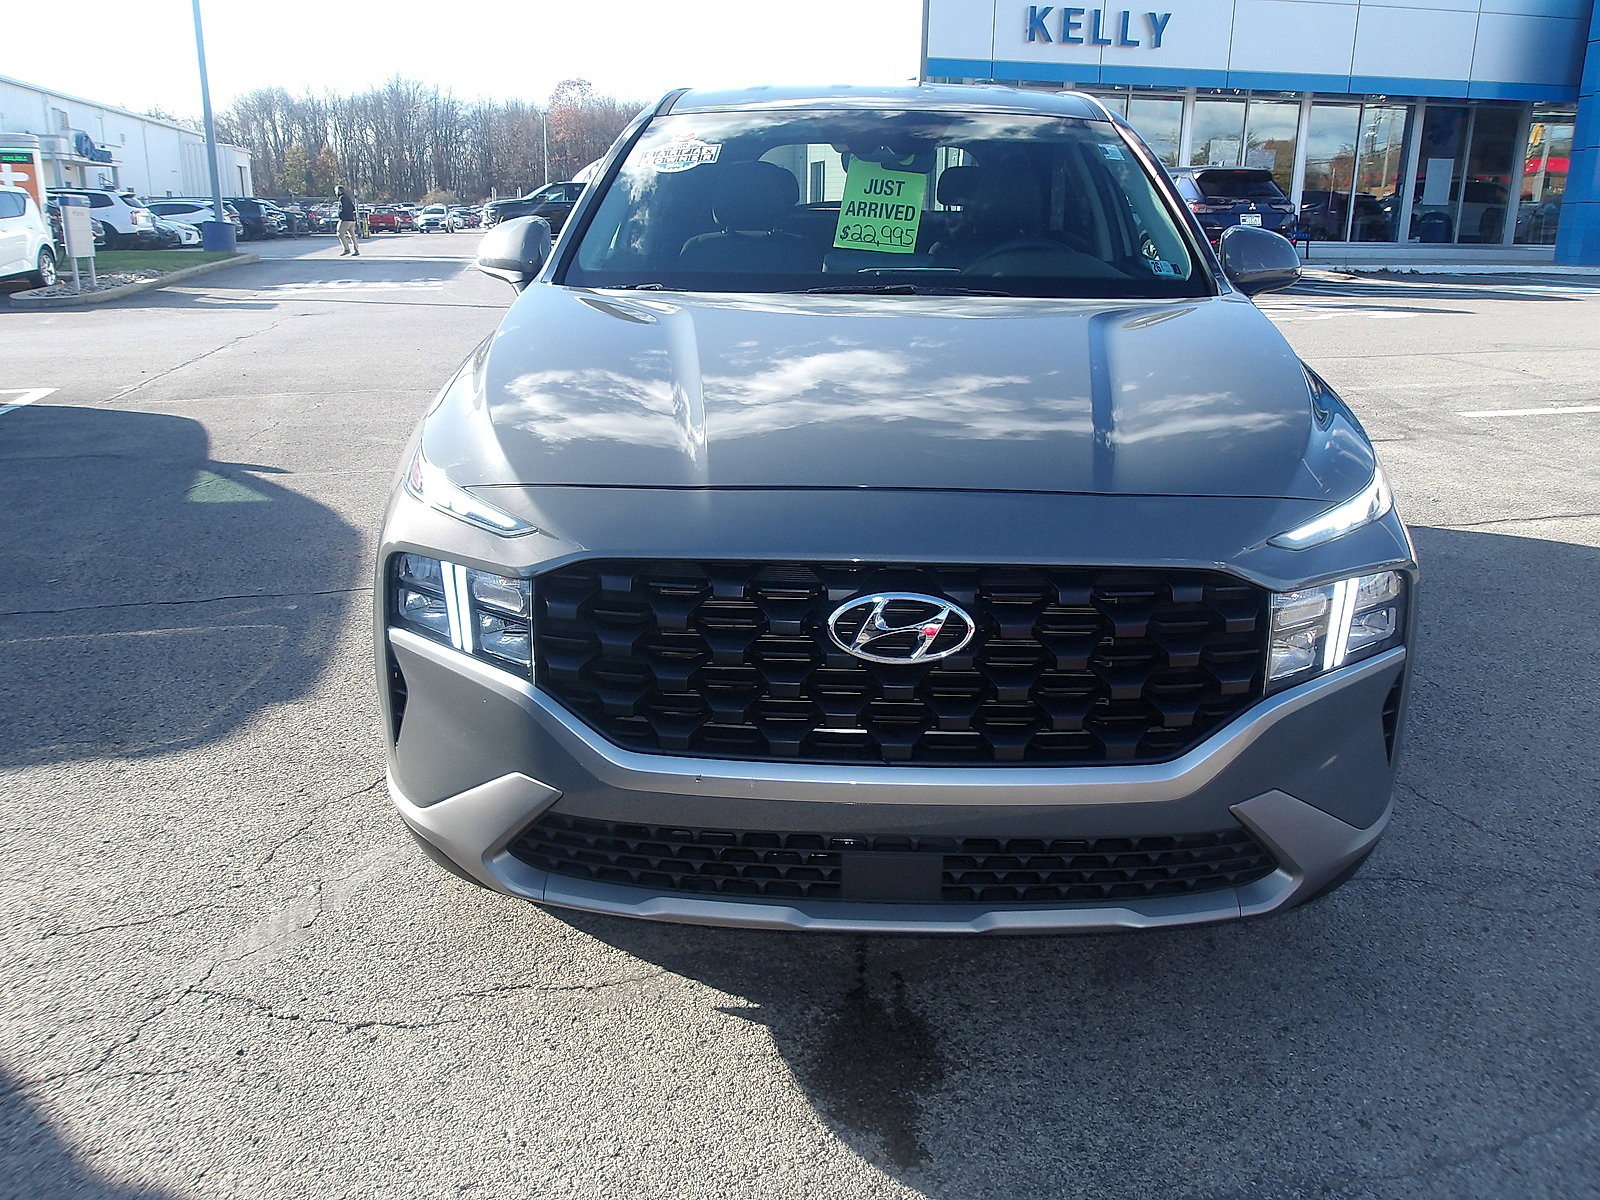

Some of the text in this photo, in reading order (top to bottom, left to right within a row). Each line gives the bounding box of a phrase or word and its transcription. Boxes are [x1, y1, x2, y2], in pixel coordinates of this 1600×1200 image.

[1026, 5, 1172, 49] KELLY
[863, 179, 905, 196] JUST
[845, 200, 916, 221] ARRIVED
[840, 223, 916, 248] $22,995
